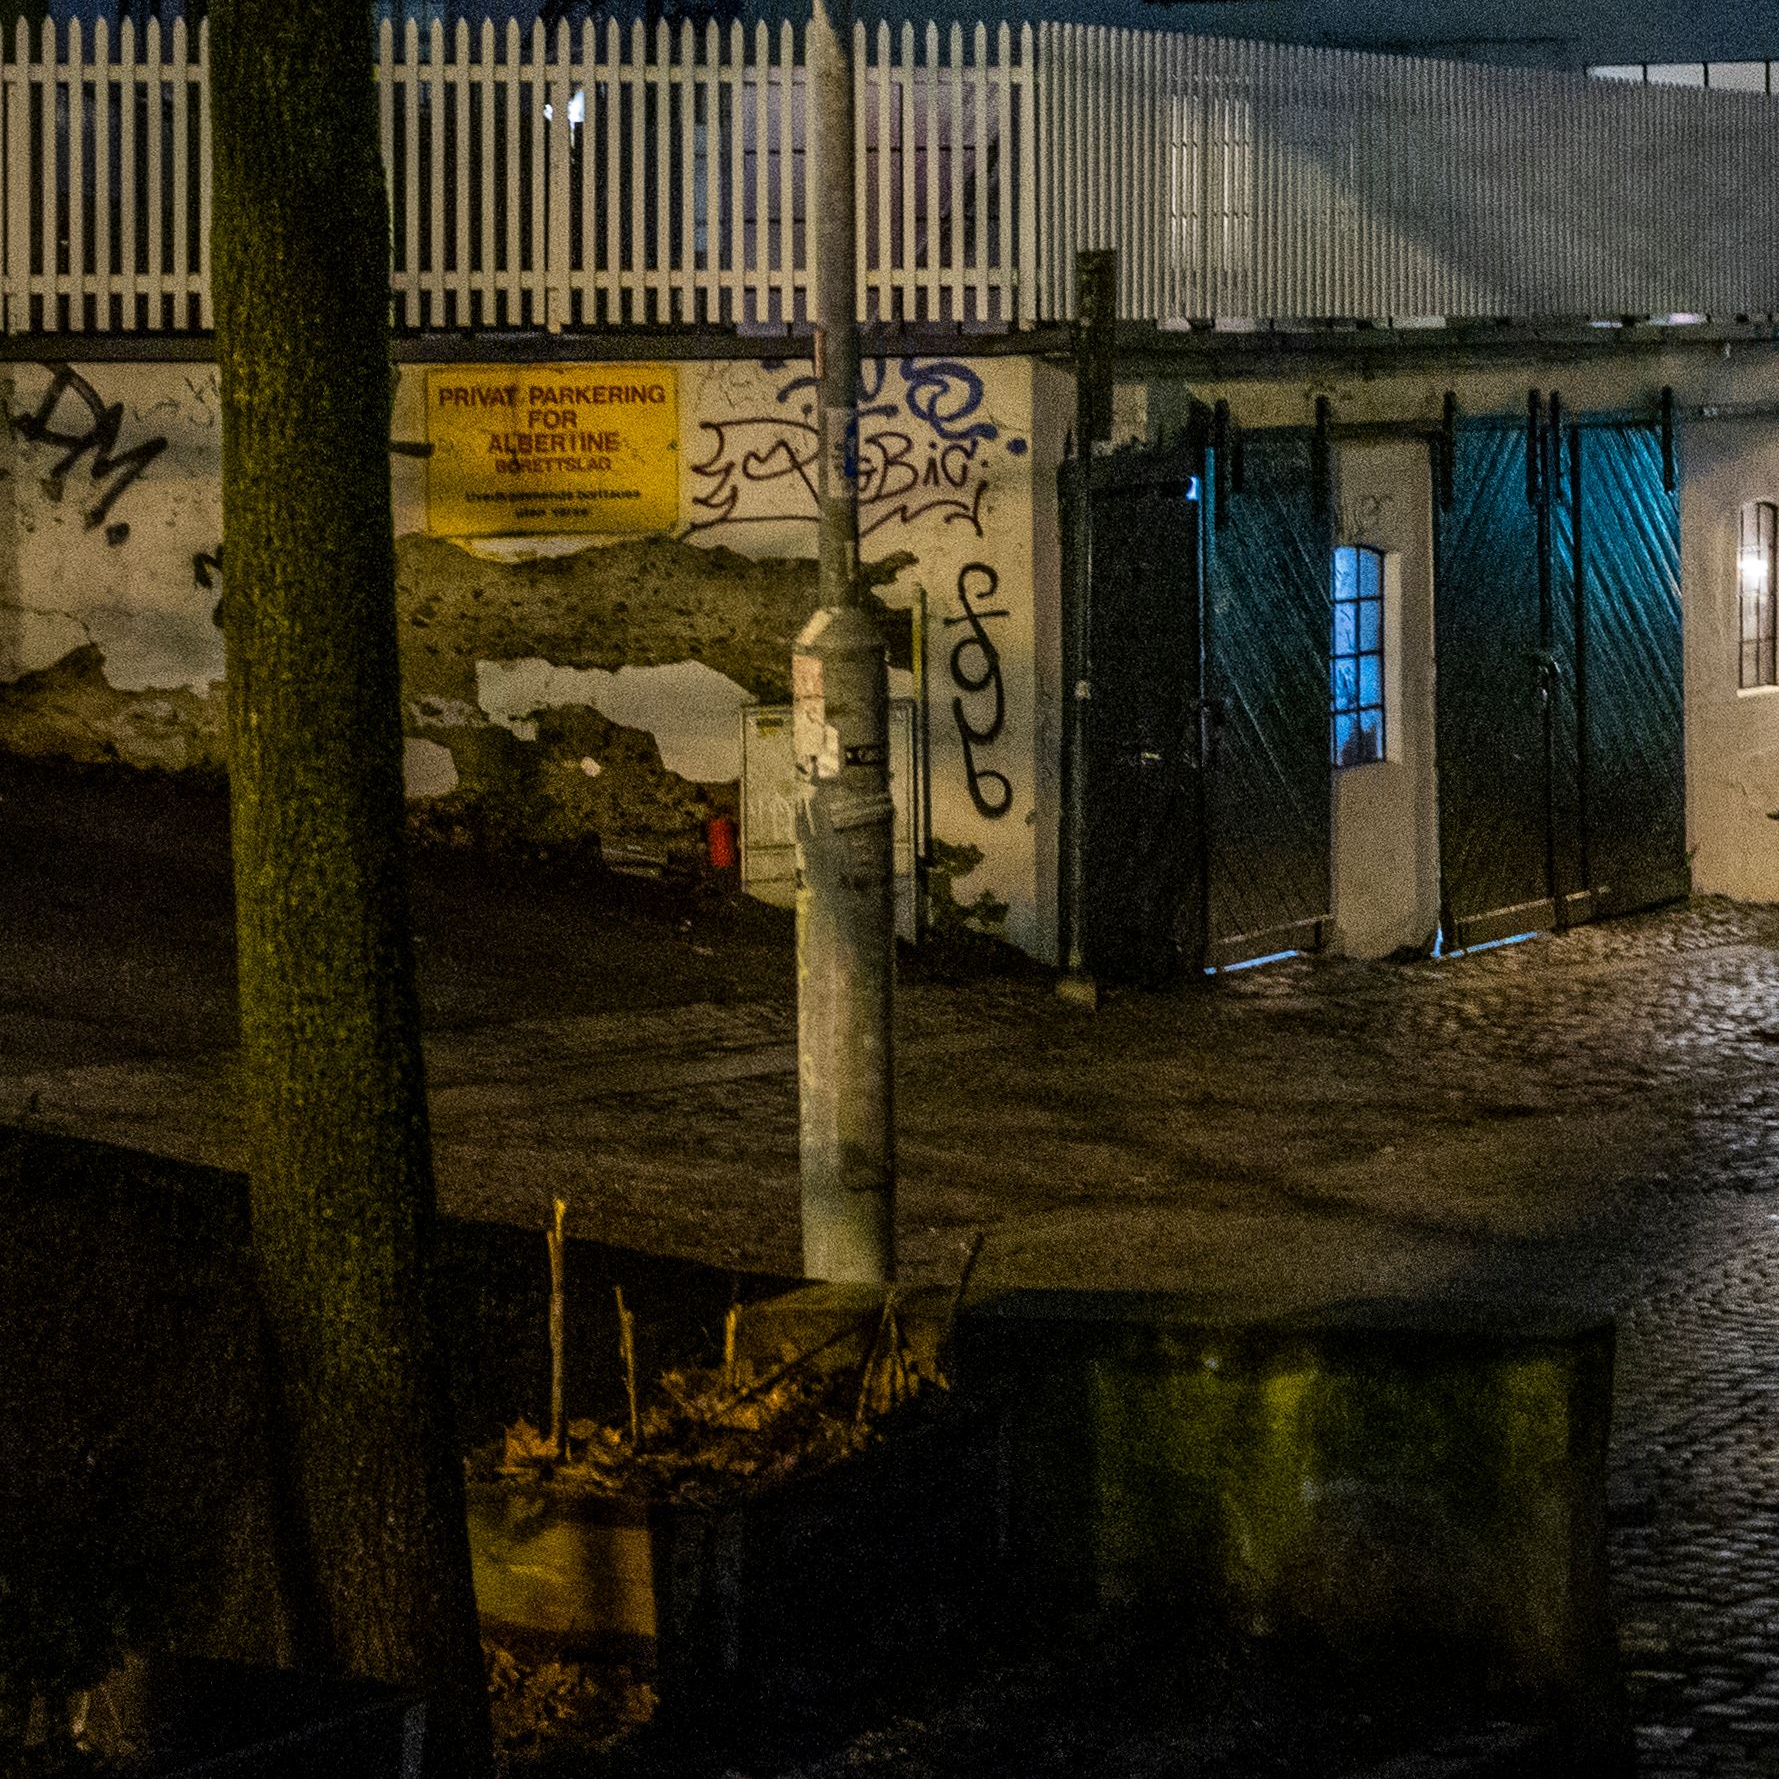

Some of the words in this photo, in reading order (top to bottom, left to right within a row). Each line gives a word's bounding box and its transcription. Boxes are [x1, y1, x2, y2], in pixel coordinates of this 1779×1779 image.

[439, 385, 518, 407] PRIVAT
[529, 385, 666, 405] PARKERING
[528, 409, 578, 429] FOR
[489, 430, 621, 453] ALBERTINE
